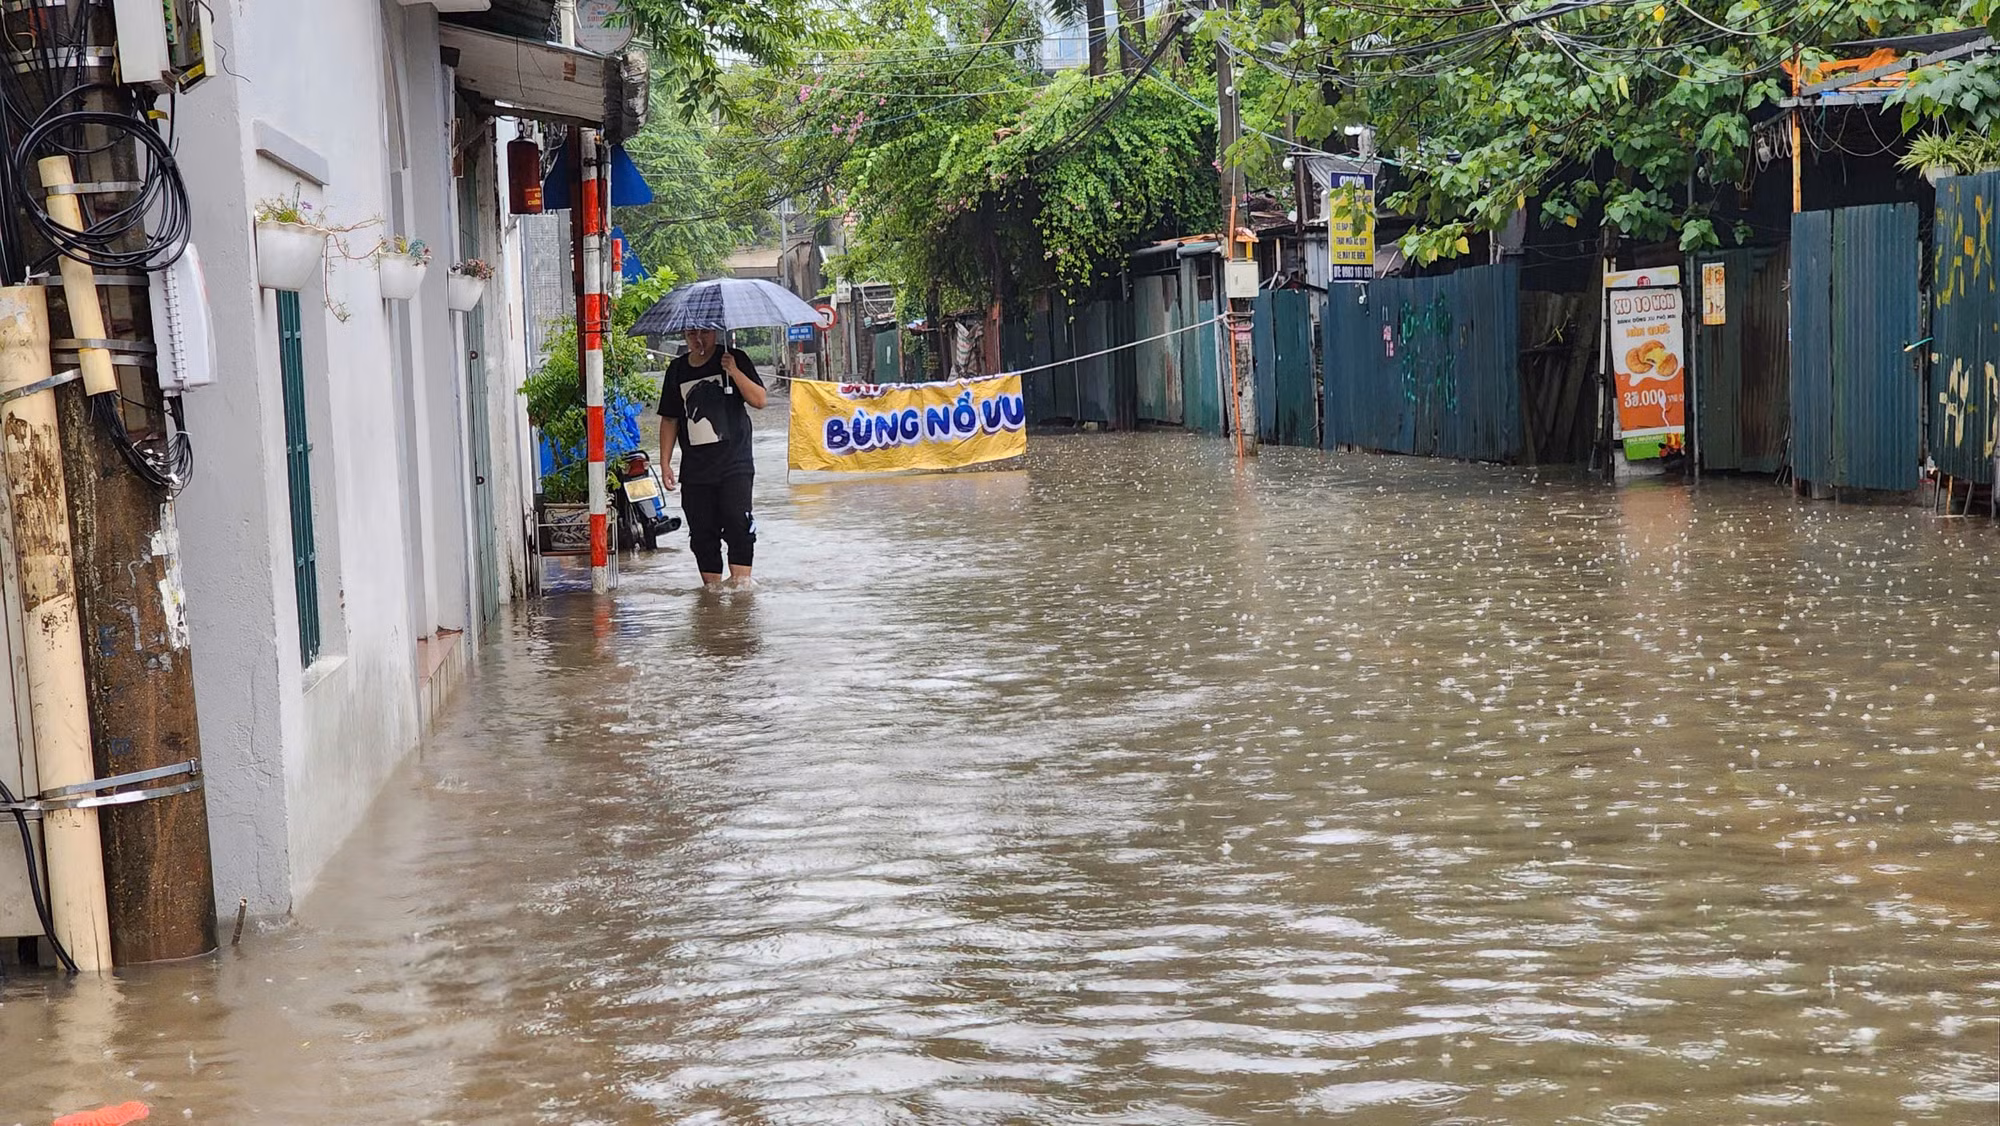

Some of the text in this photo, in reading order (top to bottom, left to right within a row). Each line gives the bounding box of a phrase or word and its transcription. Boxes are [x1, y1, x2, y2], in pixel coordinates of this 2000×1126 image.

[1614, 294, 1676, 315] XU 10 WON
[826, 408, 920, 449] BÙNG
[926, 391, 976, 438] NỔ
